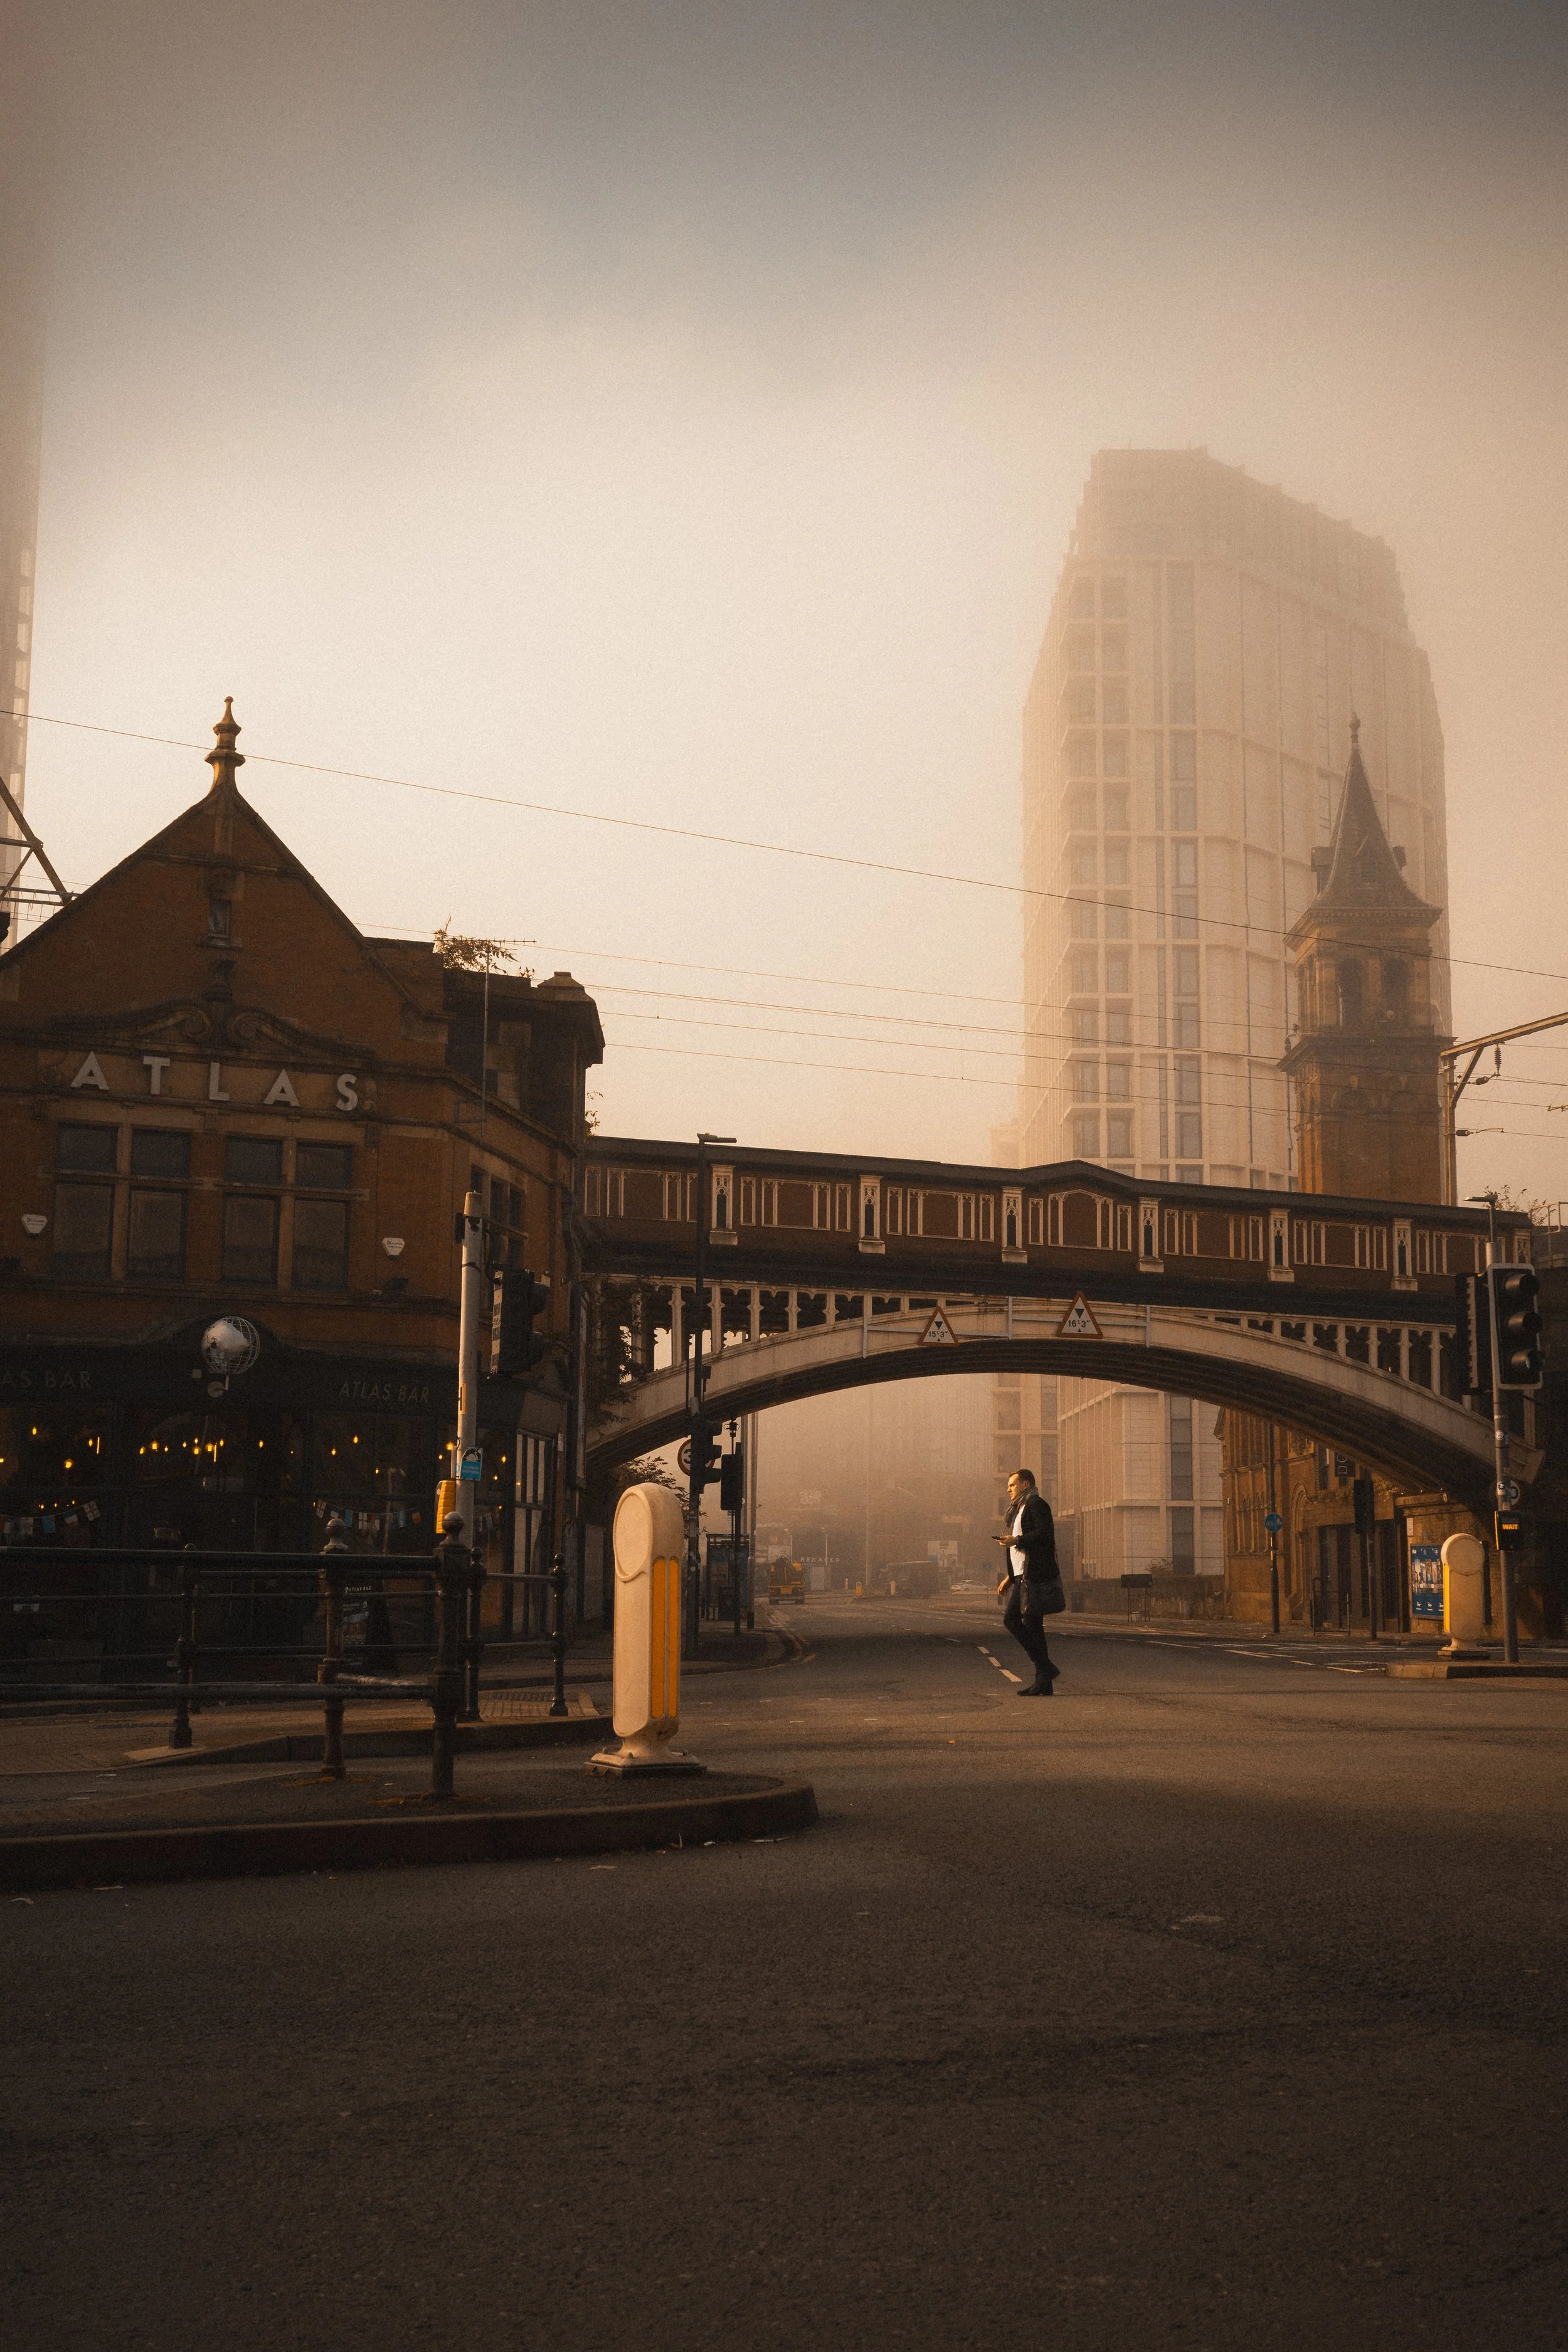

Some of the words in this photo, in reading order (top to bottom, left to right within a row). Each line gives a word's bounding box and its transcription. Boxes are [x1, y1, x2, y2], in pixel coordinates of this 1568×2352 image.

[70, 1050, 359, 1112] ATLAS
[45, 1370, 93, 1390] BAR
[339, 1380, 391, 1401] ATLAS
[398, 1384, 430, 1404] BAR
